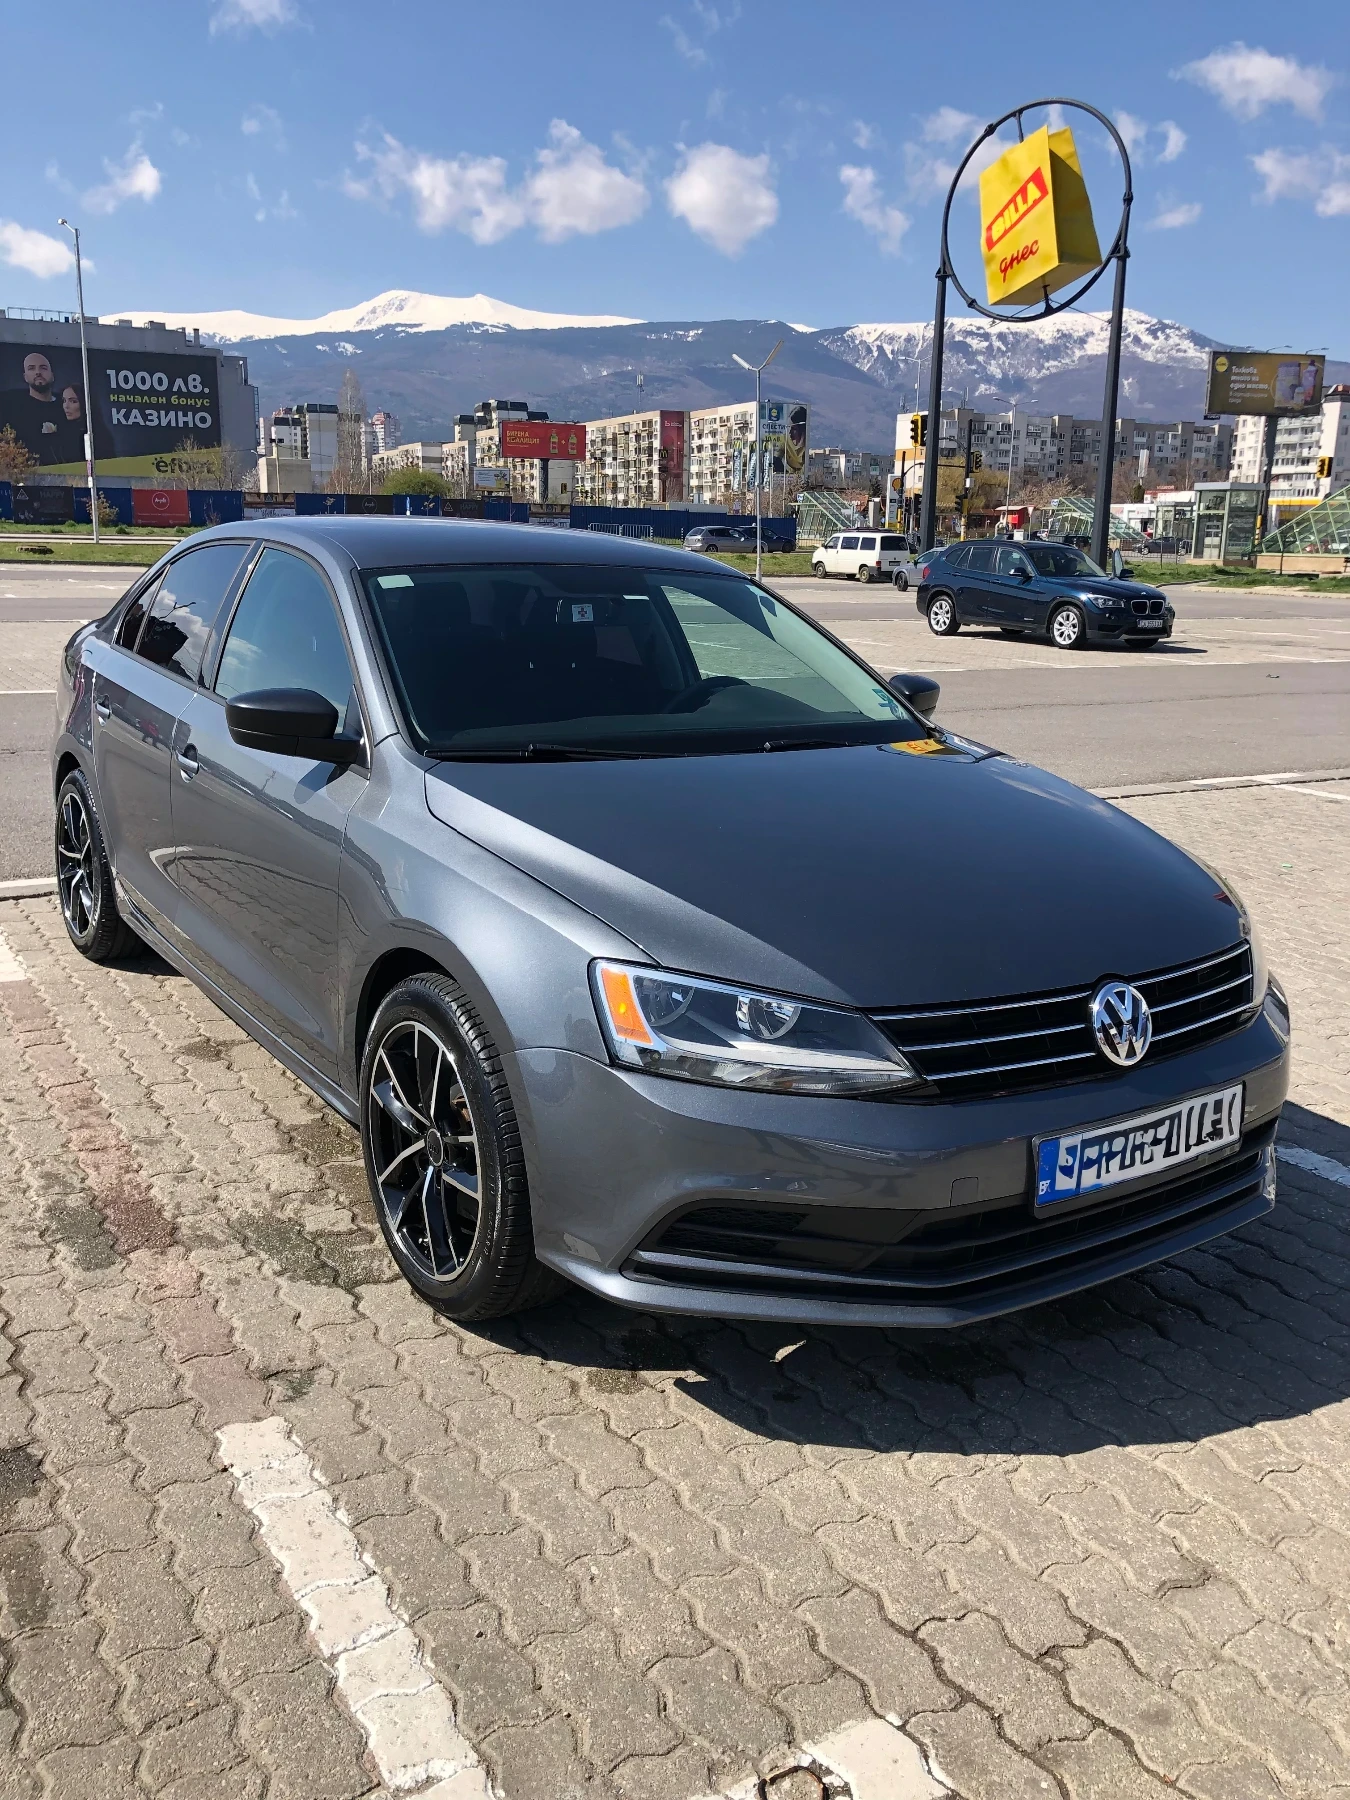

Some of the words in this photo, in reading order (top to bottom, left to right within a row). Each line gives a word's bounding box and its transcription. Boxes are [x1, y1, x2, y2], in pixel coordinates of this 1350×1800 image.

[992, 180, 1042, 242] BILLA
[106, 369, 169, 391] 1000
[172, 374, 210, 394] лв.
[110, 394, 166, 404] начален
[171, 395, 210, 408] бонус
[111, 407, 212, 428] КАЗИНО
